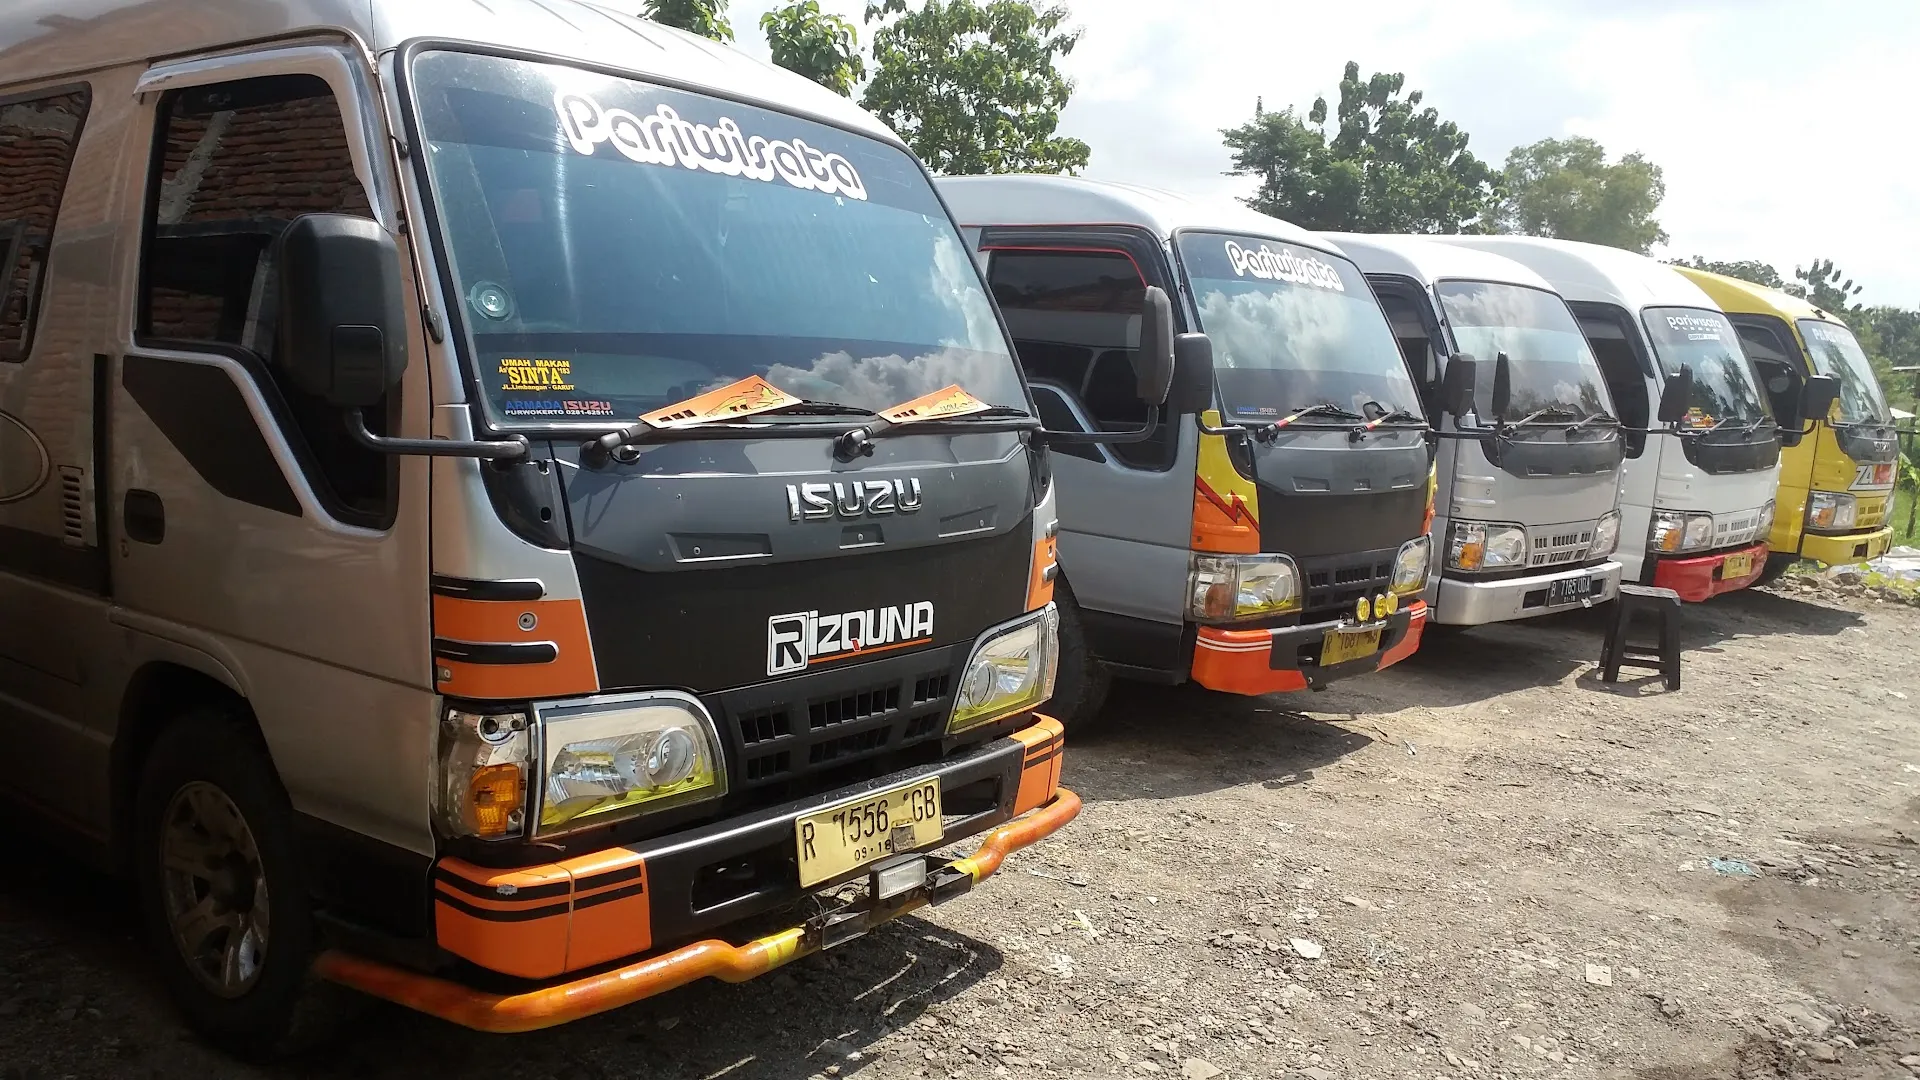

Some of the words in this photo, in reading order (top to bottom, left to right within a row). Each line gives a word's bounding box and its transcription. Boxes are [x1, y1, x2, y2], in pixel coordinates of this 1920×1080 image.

[554, 87, 867, 201] Pariwisata
[1224, 240, 1344, 292] Pariwisata
[1666, 314, 1721, 328] pariwisata
[501, 358, 531, 367] UMAH
[535, 359, 570, 368] MAKAN
[505, 400, 562, 410] ARMADA
[563, 401, 611, 411] ISUZU
[787, 478, 922, 521] ISUZU
[803, 822, 816, 862] R
[838, 799, 889, 847] 1556
[911, 785, 937, 823] GB
